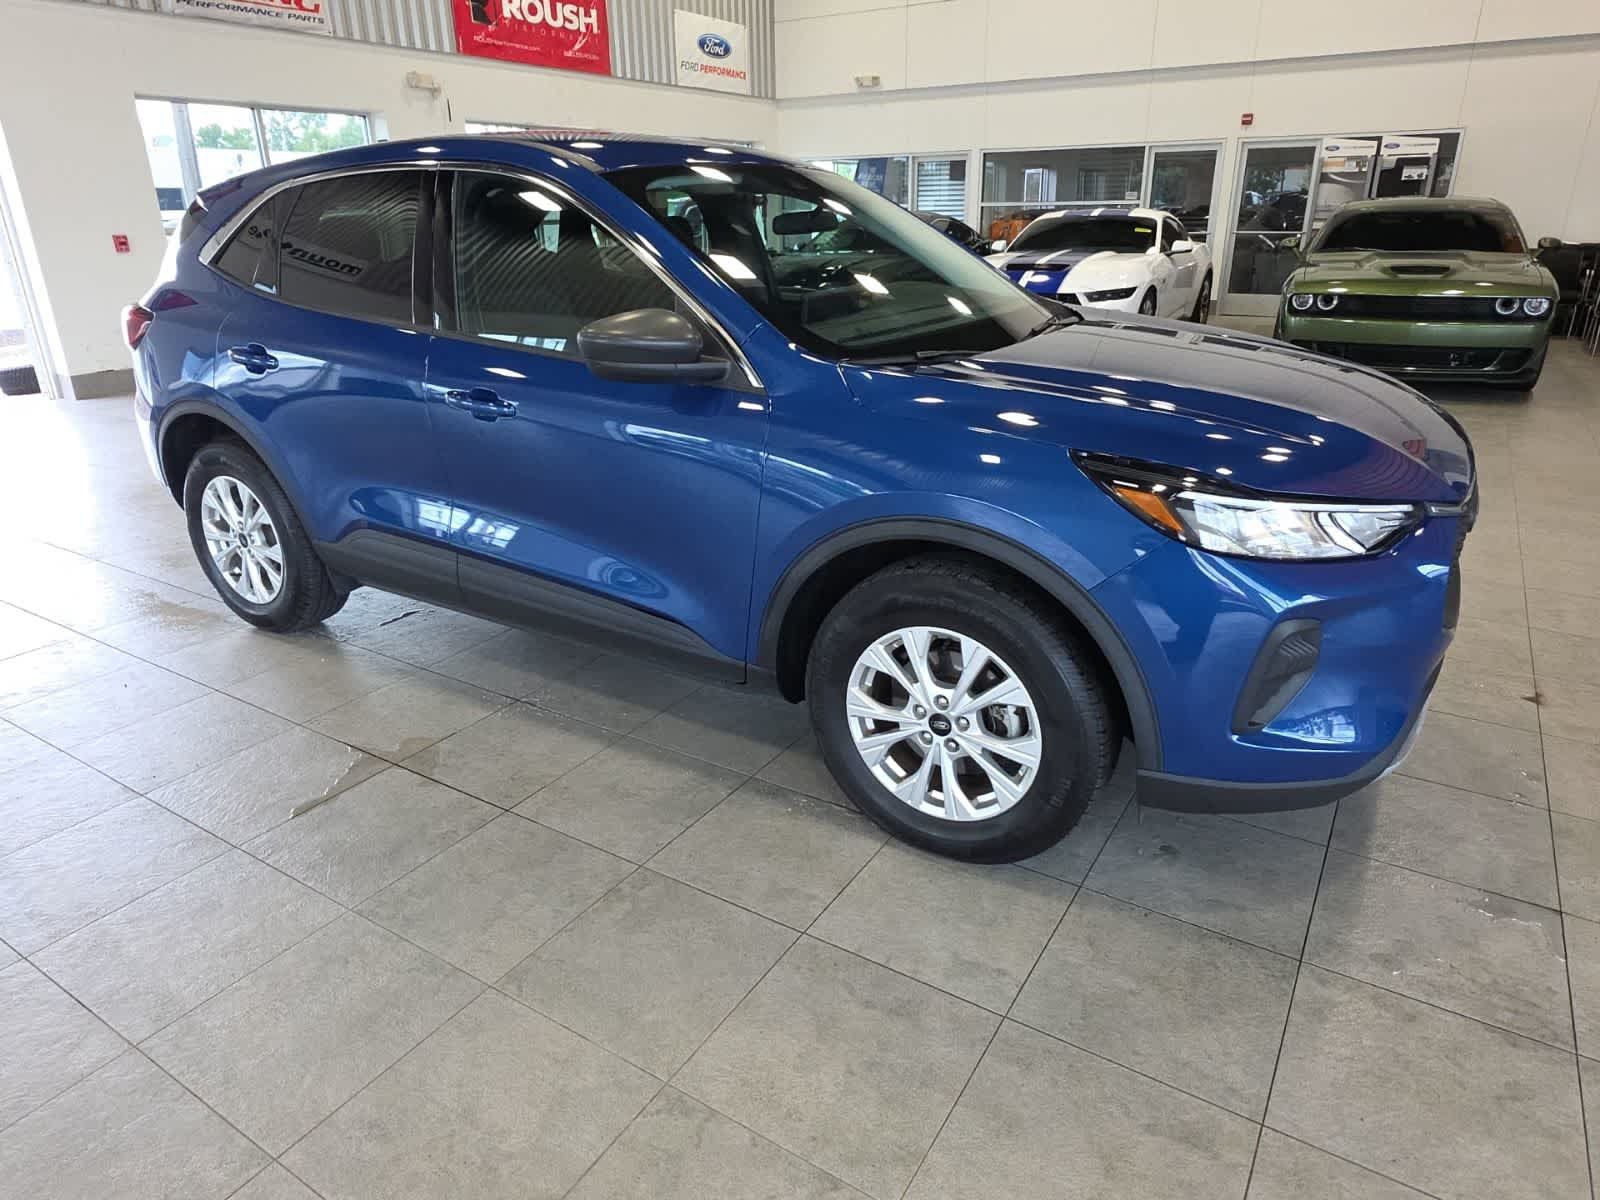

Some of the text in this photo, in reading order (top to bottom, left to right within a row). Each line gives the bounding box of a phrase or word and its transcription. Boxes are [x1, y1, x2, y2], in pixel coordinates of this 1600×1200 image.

[176, 0, 284, 18] PERFORMANCE
[288, 13, 325, 25] PARTS
[502, 0, 599, 34] ROUSH
[680, 60, 747, 80] FORD PERFORMANCE
